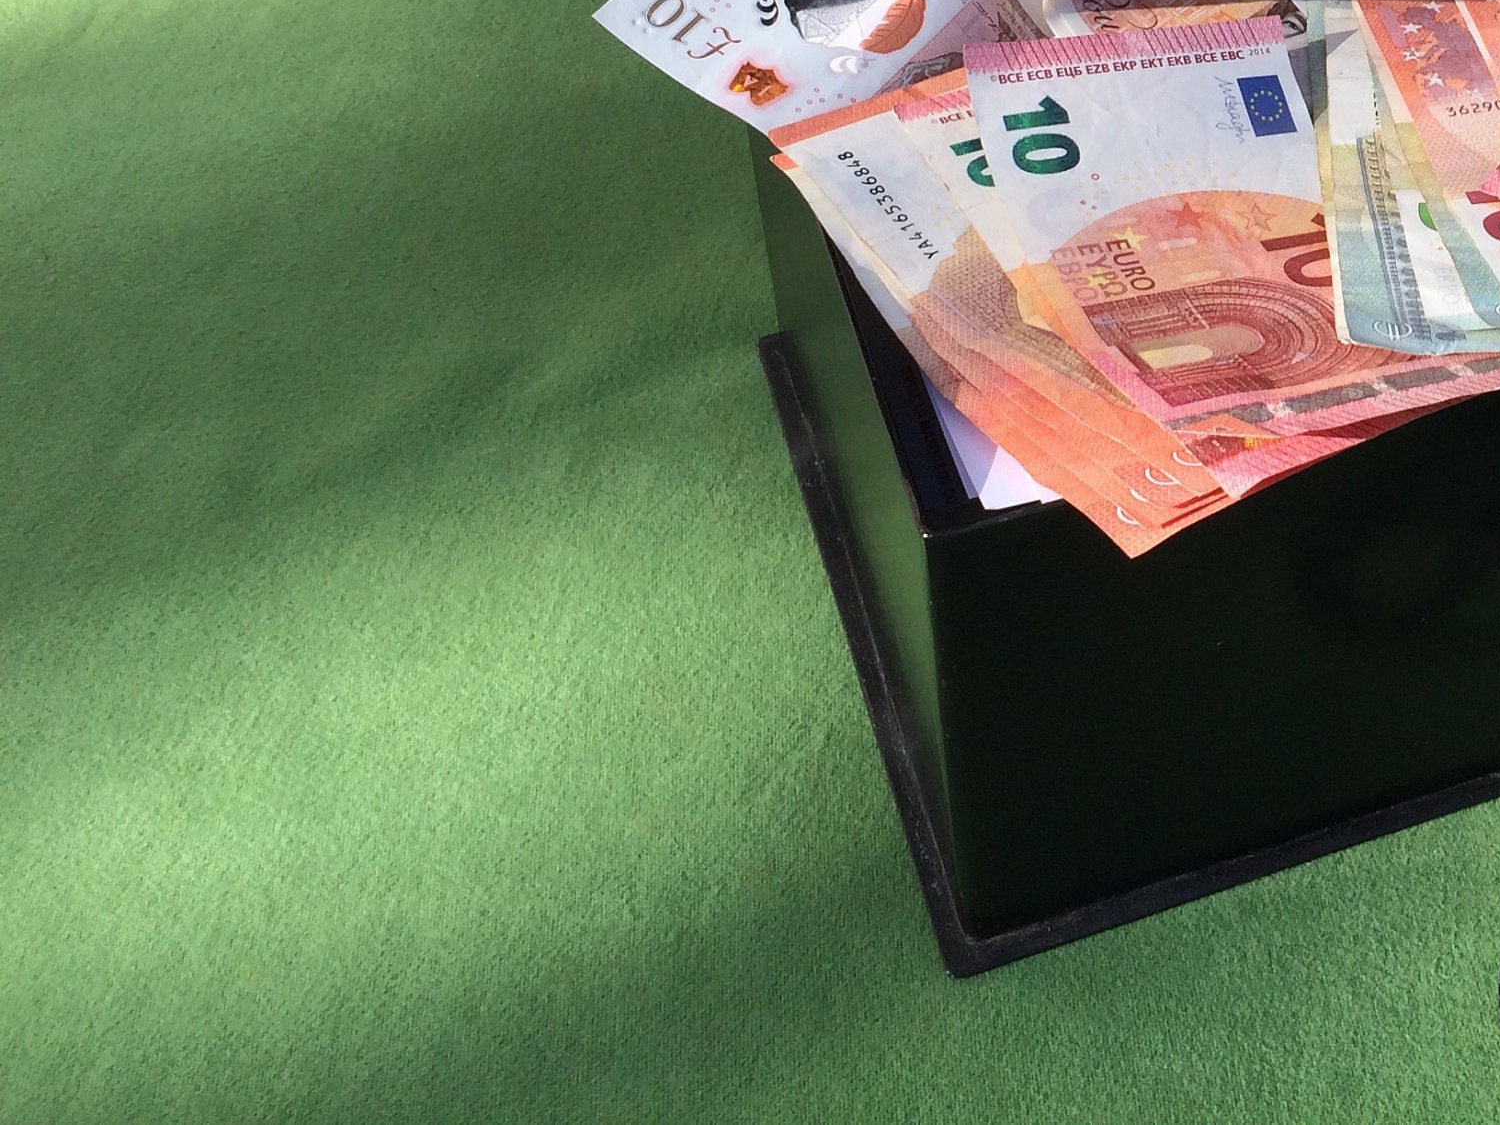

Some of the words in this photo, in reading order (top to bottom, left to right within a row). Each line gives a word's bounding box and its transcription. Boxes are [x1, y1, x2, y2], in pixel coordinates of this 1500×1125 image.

[1027, 69, 1053, 81] ECB
[1086, 63, 1110, 76] EZB
[1113, 60, 1137, 72] EKP
[1141, 57, 1164, 69] EKT
[1168, 54, 1192, 67] EKB
[1221, 49, 1245, 61] EBC
[1249, 47, 1271, 57] 2014
[1002, 95, 1081, 175] 10
[837, 151, 939, 260] YA4165386848
[1105, 238, 1156, 291] EURO
